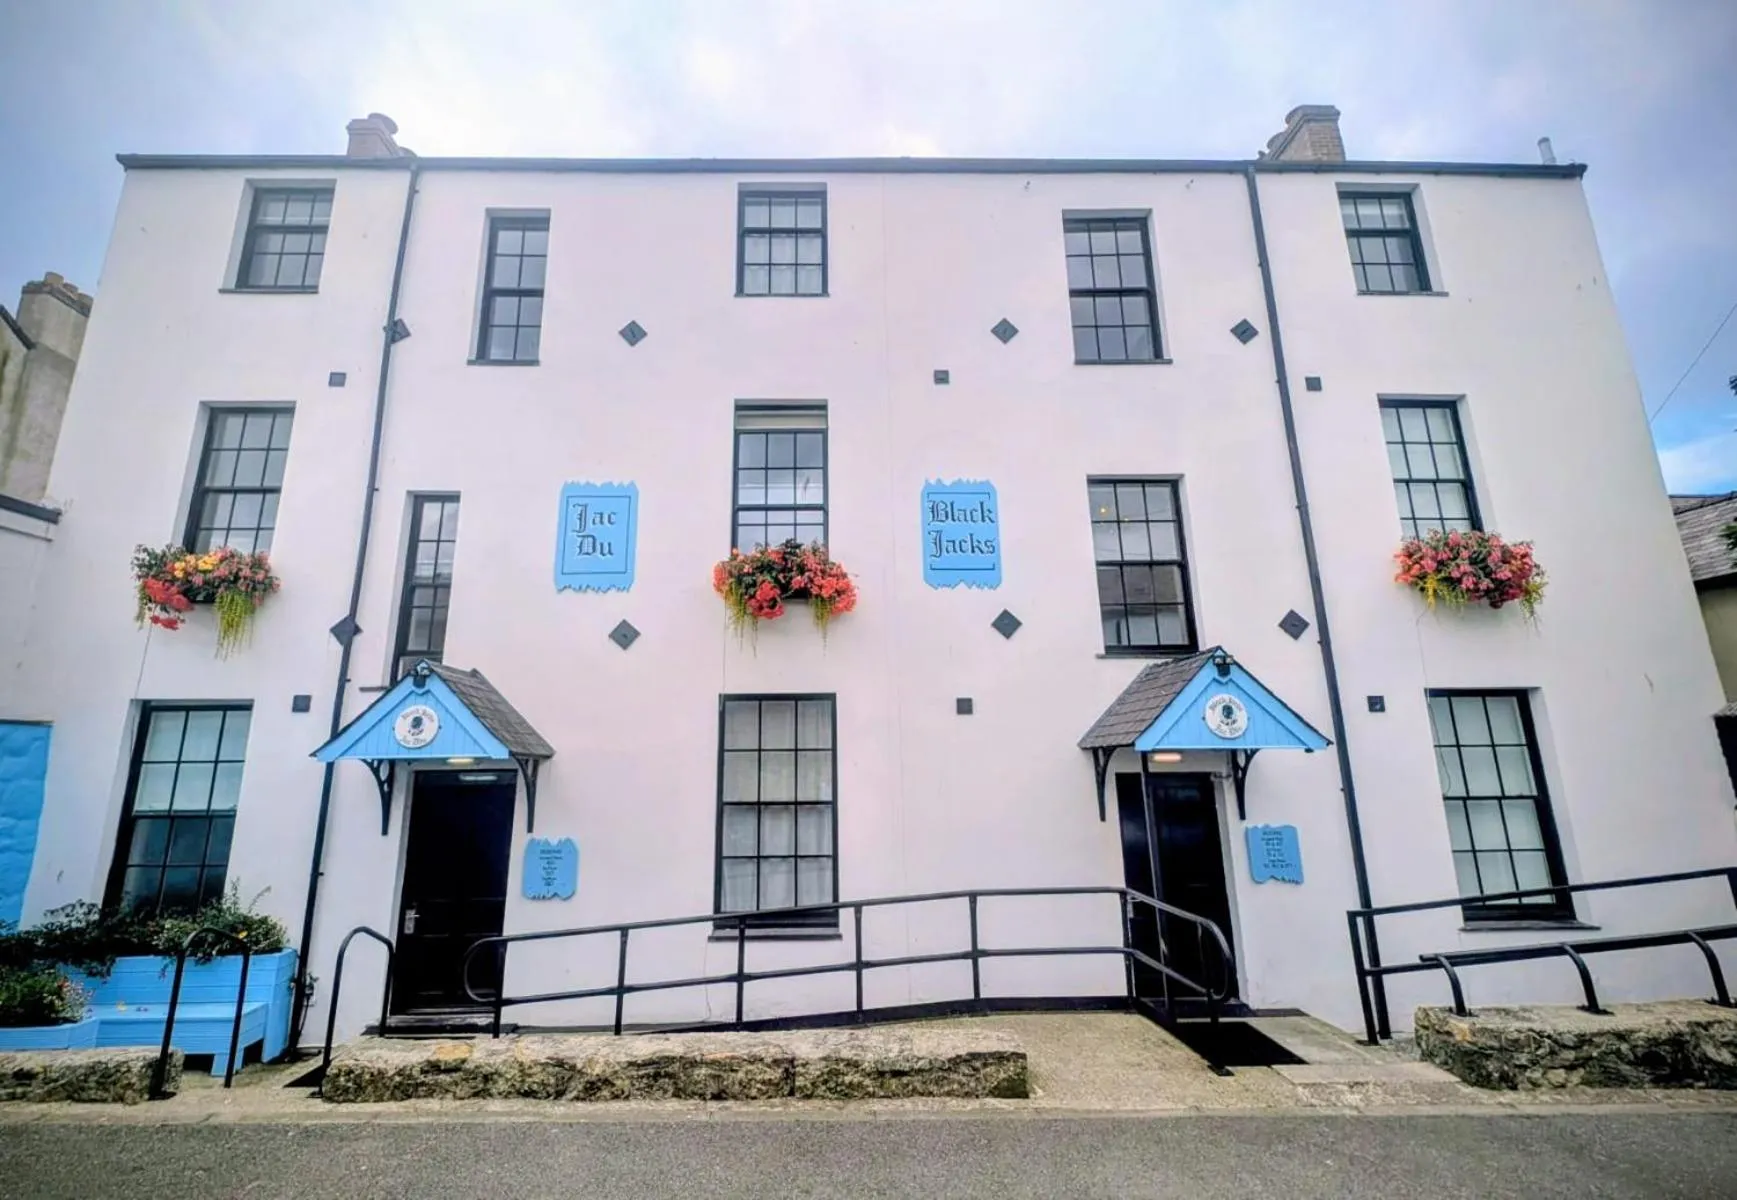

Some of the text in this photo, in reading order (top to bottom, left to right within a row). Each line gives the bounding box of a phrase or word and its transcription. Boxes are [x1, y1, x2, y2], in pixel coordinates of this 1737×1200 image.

[571, 503, 618, 533] Jac
[927, 500, 995, 525] Black
[576, 534, 614, 556] Du
[928, 529, 996, 558] Jacks
